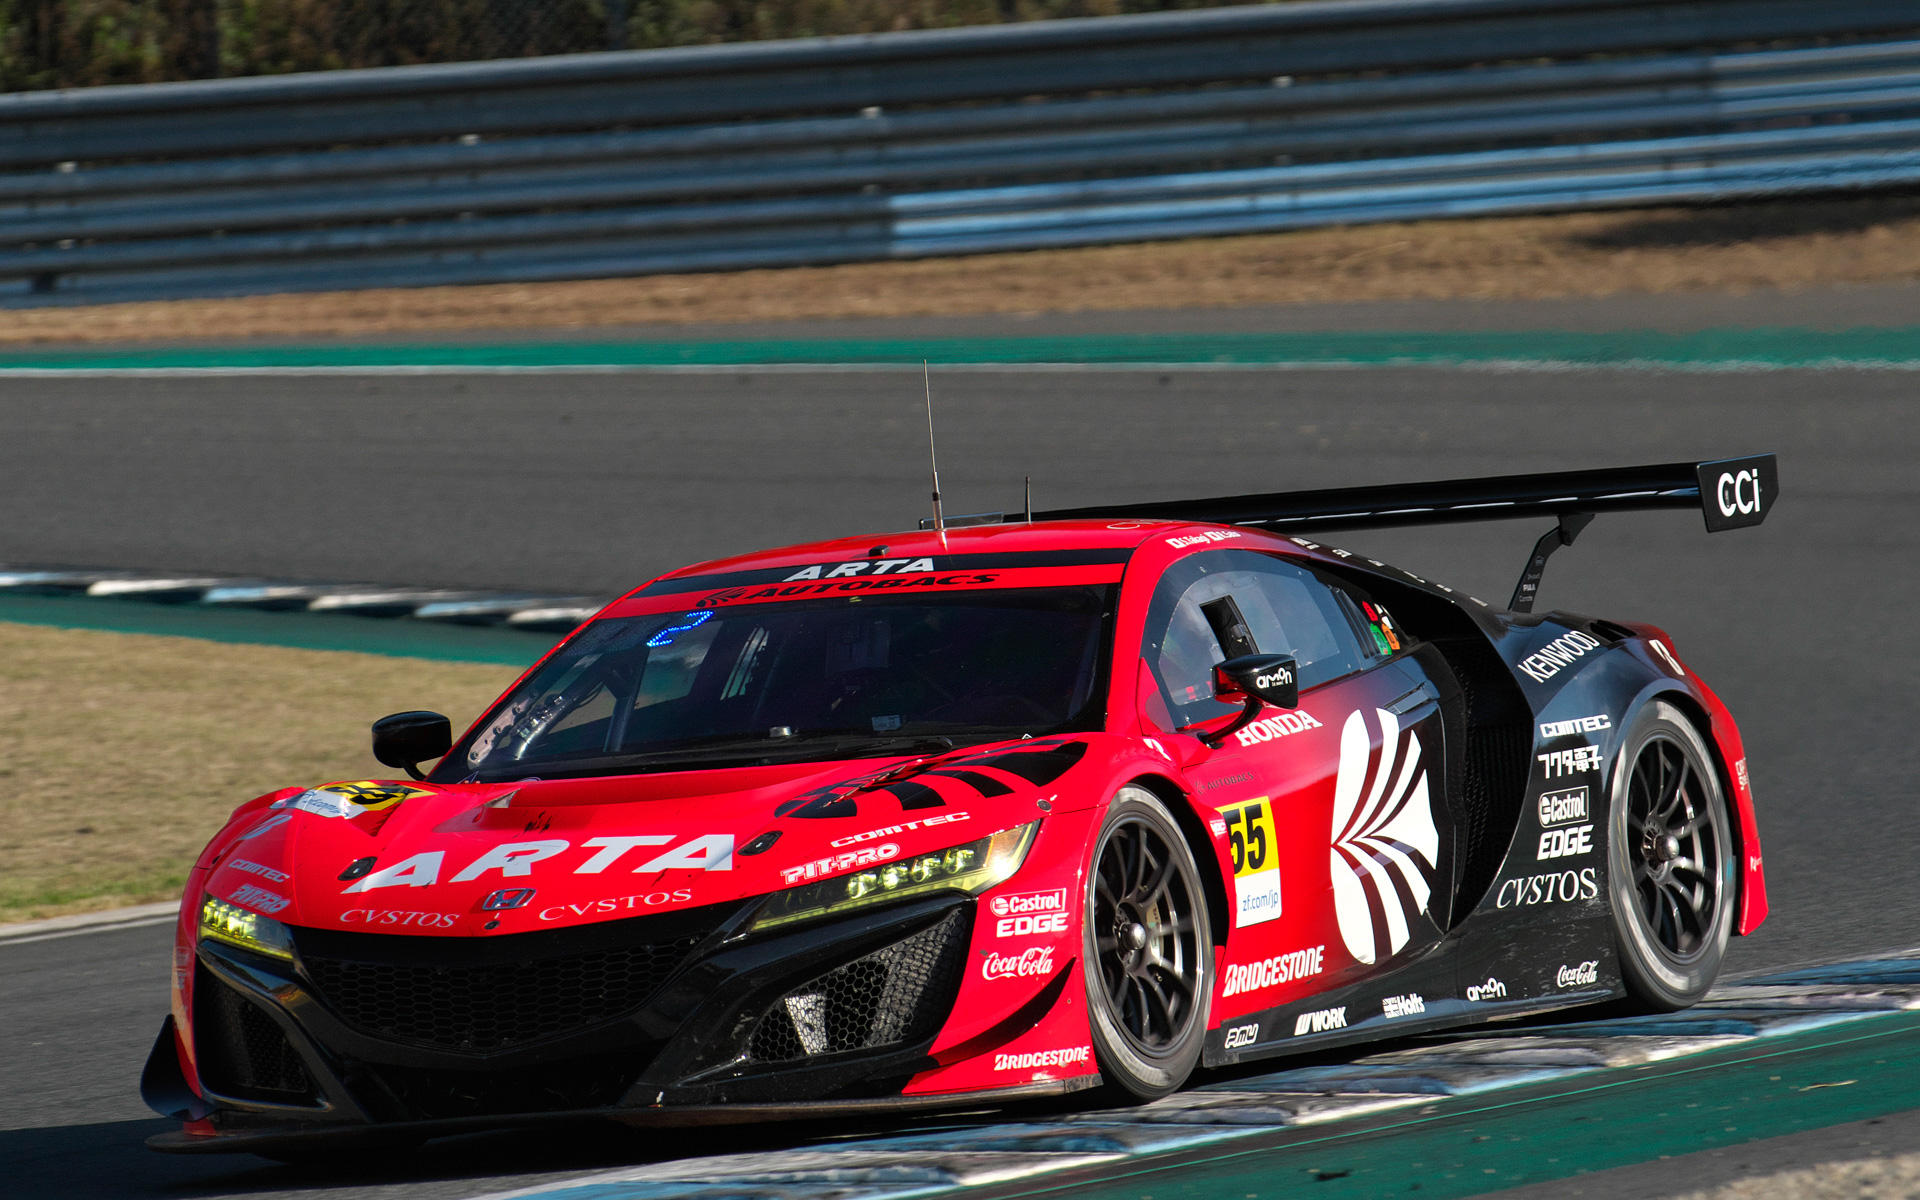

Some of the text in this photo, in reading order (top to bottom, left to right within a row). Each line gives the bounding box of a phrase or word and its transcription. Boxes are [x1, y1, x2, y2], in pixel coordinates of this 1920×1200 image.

[1717, 468, 1762, 518] CCi
[782, 557, 935, 583] ARTA
[742, 573, 1000, 601] AUTOBACS
[1517, 629, 1602, 684] KENWOOD
[1233, 709, 1323, 747] HONDA
[1539, 714, 1612, 738] COMTEC
[1206, 771, 1255, 791] AUTOBACS
[1550, 790, 1587, 822] Castrol
[830, 811, 971, 849] COMTEC
[1222, 803, 1267, 875] 55
[1537, 824, 1594, 861] EDGE
[228, 858, 290, 883] COMTEC
[341, 833, 735, 894] ARTA
[780, 842, 901, 885] PIT-PRO
[1008, 890, 1061, 914] Castrol
[1242, 889, 1279, 912] zf.com/jp
[1496, 867, 1599, 909] CVSTOS
[339, 908, 460, 929] CVSTOS
[539, 887, 692, 922] CVSTOS
[996, 912, 1069, 938] EDGE
[982, 945, 1056, 981] Coca-Cola
[1222, 945, 1325, 998] BRIDGESTONE
[1556, 959, 1600, 989] Coca-Cola
[1311, 1006, 1348, 1033] WORK
[1397, 992, 1426, 1016] Holts
[993, 1045, 1091, 1072] BRIDGESTONE
